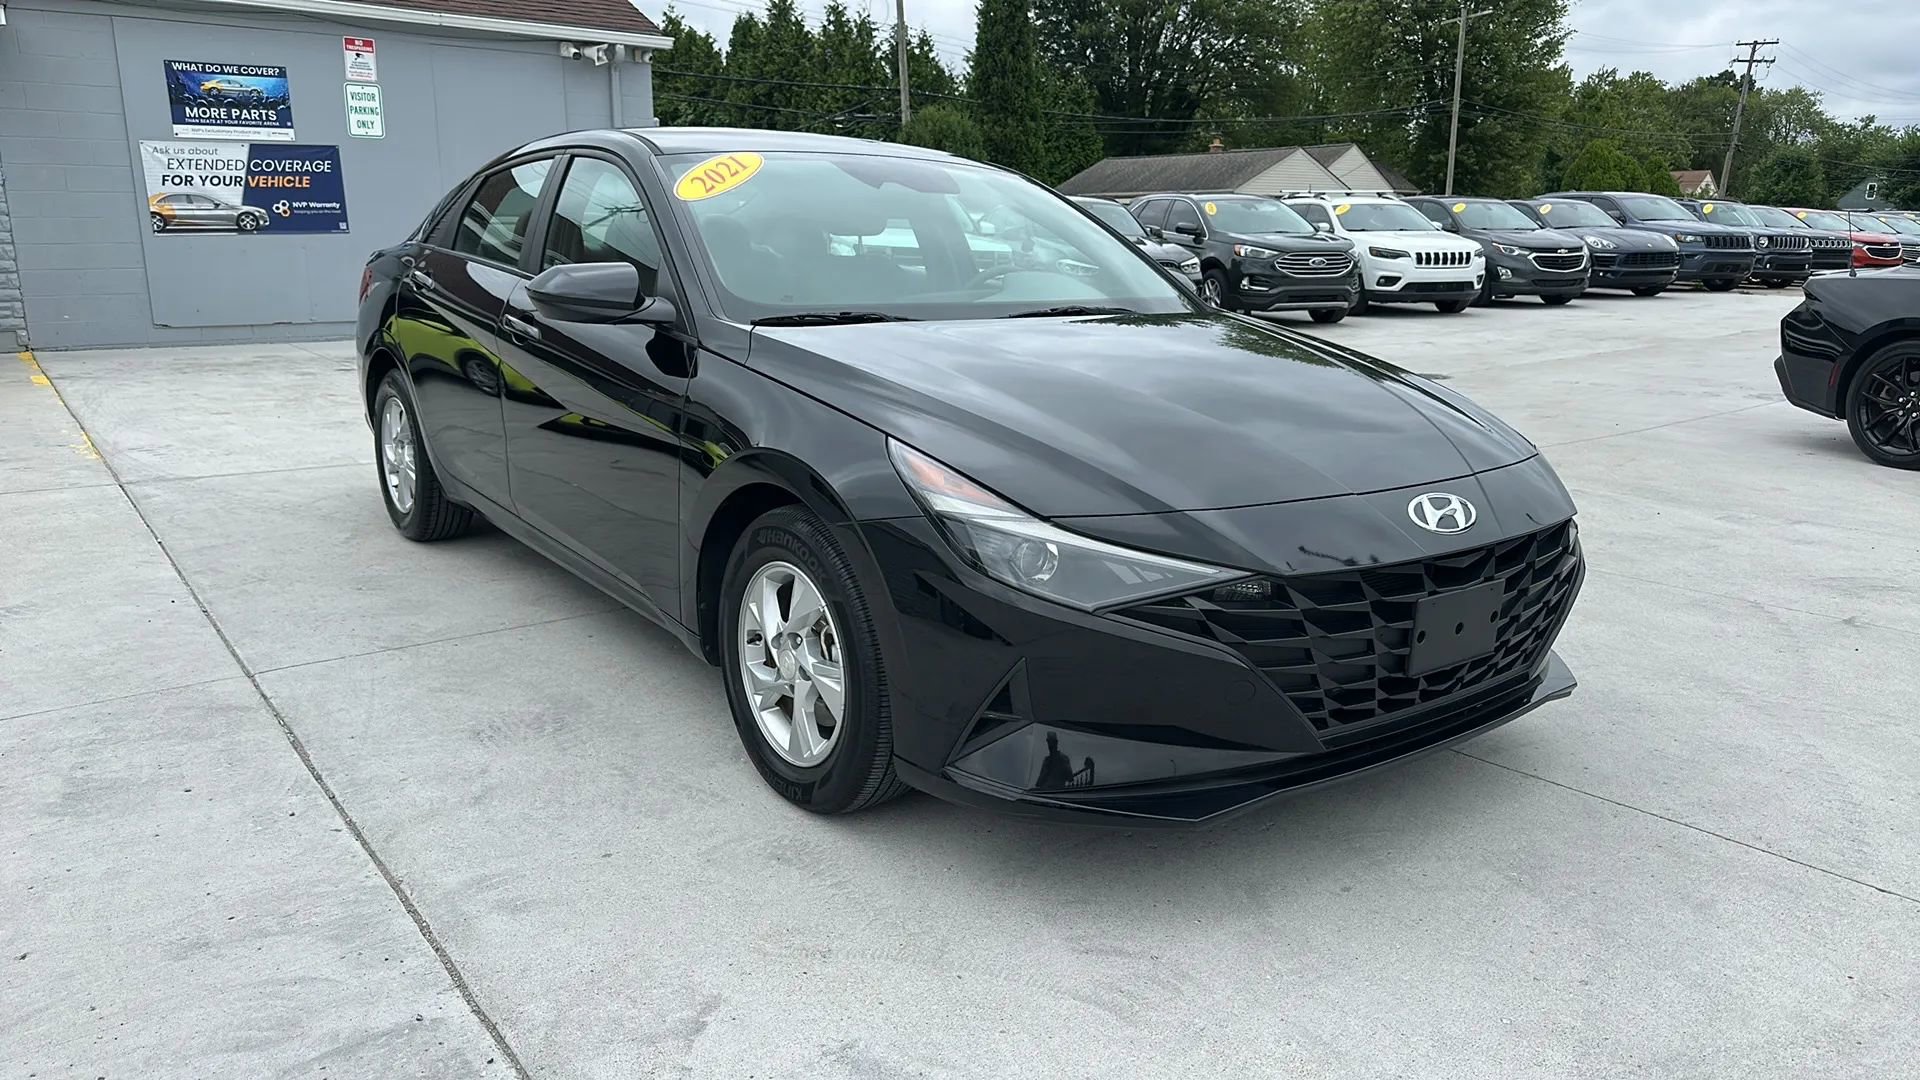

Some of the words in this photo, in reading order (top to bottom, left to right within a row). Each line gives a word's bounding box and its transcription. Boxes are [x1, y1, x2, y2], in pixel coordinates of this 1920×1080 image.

[171, 62, 203, 71] WHAT
[205, 64, 221, 73] DO
[223, 65, 239, 74] WE
[240, 66, 280, 76] COVER?
[350, 92, 376, 102] VISITOR
[185, 106, 228, 119] MORE
[231, 108, 277, 121] PARTS
[350, 106, 379, 116] PARKING
[356, 120, 375, 129] ONLY
[152, 146, 170, 155] Ask
[173, 147, 186, 155] us
[188, 147, 219, 156] about
[167, 158, 246, 171] EXTENDED
[250, 159, 332, 172] COVERAGE
[161, 174, 194, 186] FOR
[198, 175, 244, 187] YOUR
[247, 175, 311, 187] VEHICLE
[690, 156, 749, 194] 2021
[292, 201, 308, 209] NVP
[308, 201, 340, 210] Warranty
